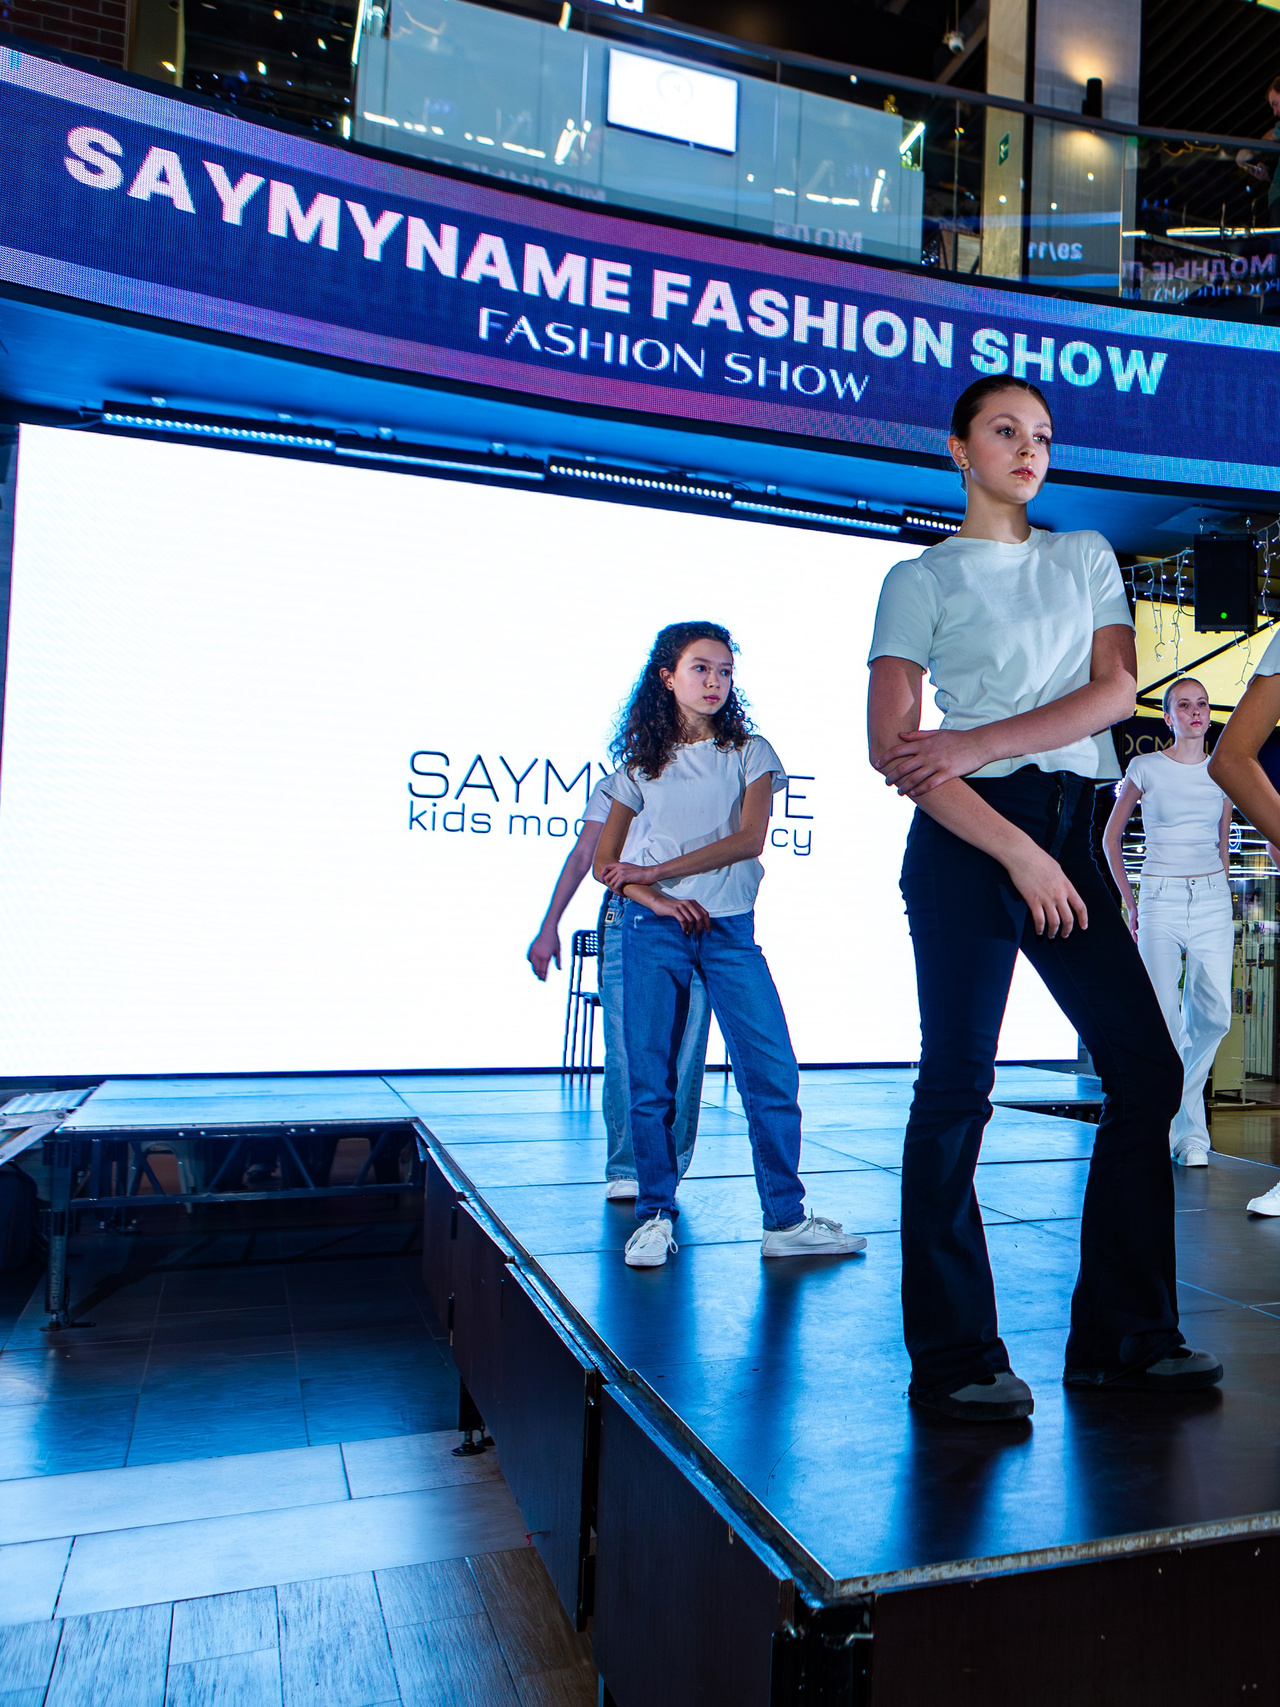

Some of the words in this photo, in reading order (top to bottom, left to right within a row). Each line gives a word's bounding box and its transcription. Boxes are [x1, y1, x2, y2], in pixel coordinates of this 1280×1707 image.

[64, 125, 632, 314] SAYMYNAME
[651, 268, 954, 368] FASHION
[971, 328, 1169, 396] SHOW
[478, 305, 706, 379] FASHION
[723, 351, 869, 402] SHOW
[407, 750, 816, 820] SAYME
[408, 800, 492, 834] kids
